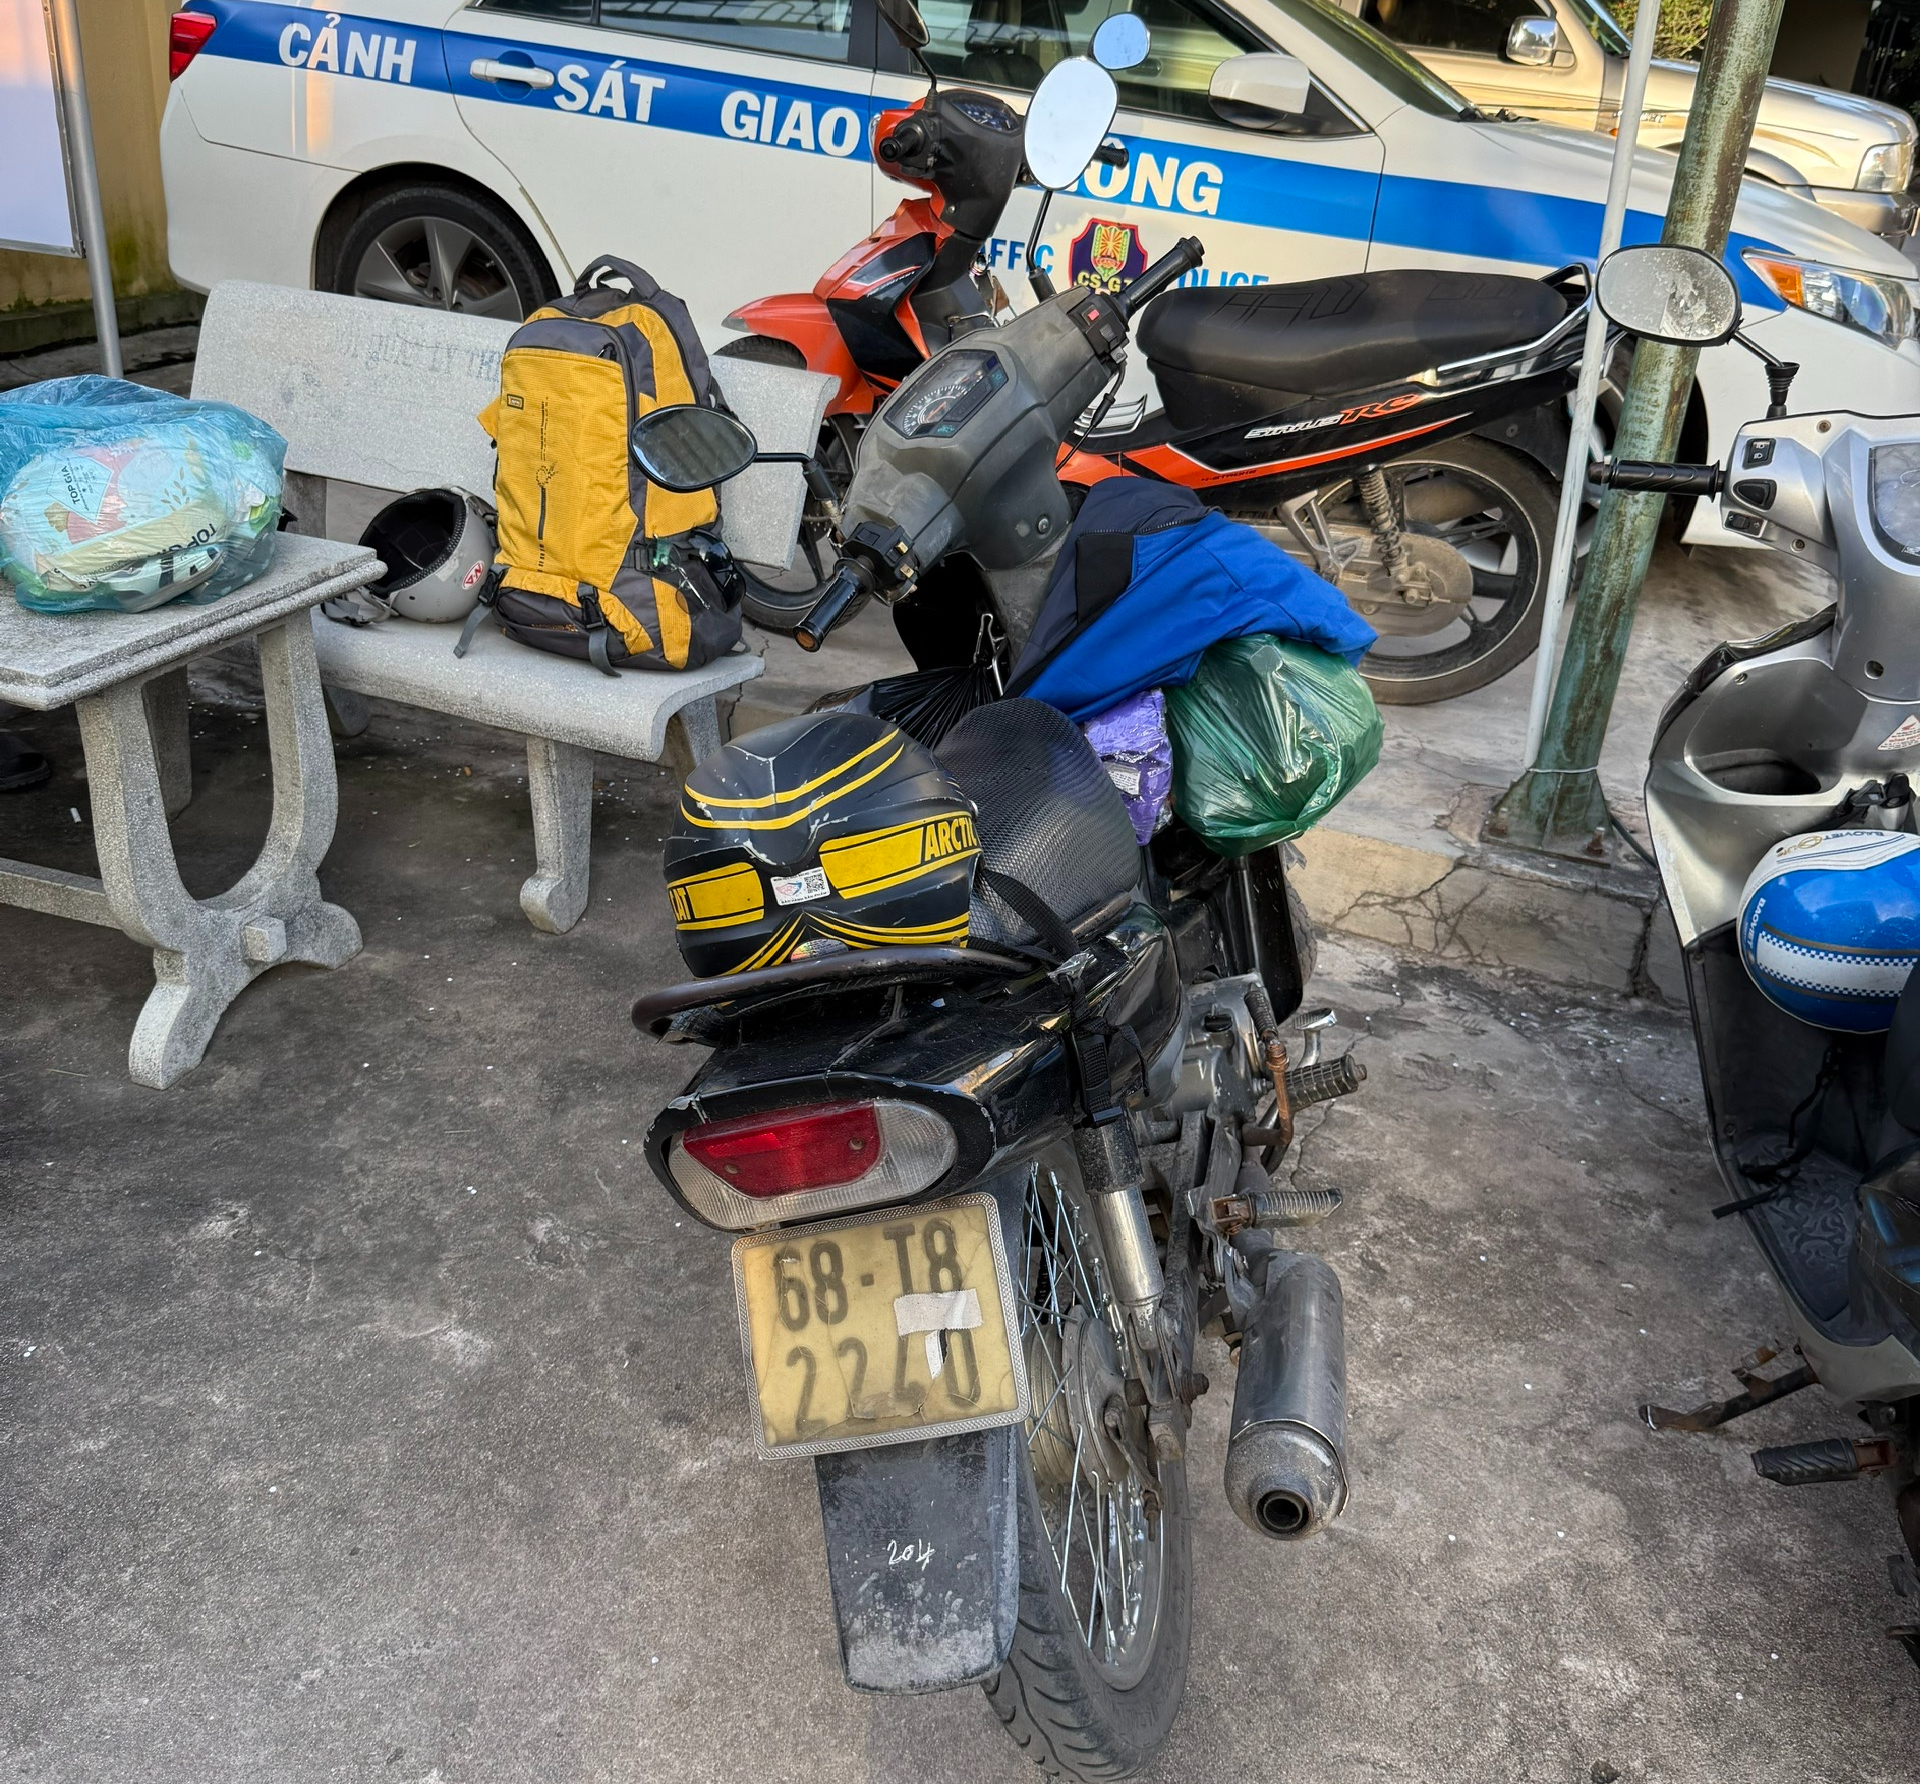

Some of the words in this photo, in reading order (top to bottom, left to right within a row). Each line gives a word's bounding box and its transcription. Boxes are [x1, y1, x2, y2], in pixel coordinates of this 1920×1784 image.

[278, 13, 417, 84] CẢNH
[553, 60, 666, 123] SÁT
[720, 90, 861, 157] GIAO
[1064, 136, 1223, 215] ÔNG
[61, 465, 74, 484] GIA
[67, 483, 81, 505] TOP
[1748, 898, 1766, 949] BAOVIET
[773, 1218, 963, 1332] 68-T8
[886, 1538, 936, 1572] 204
